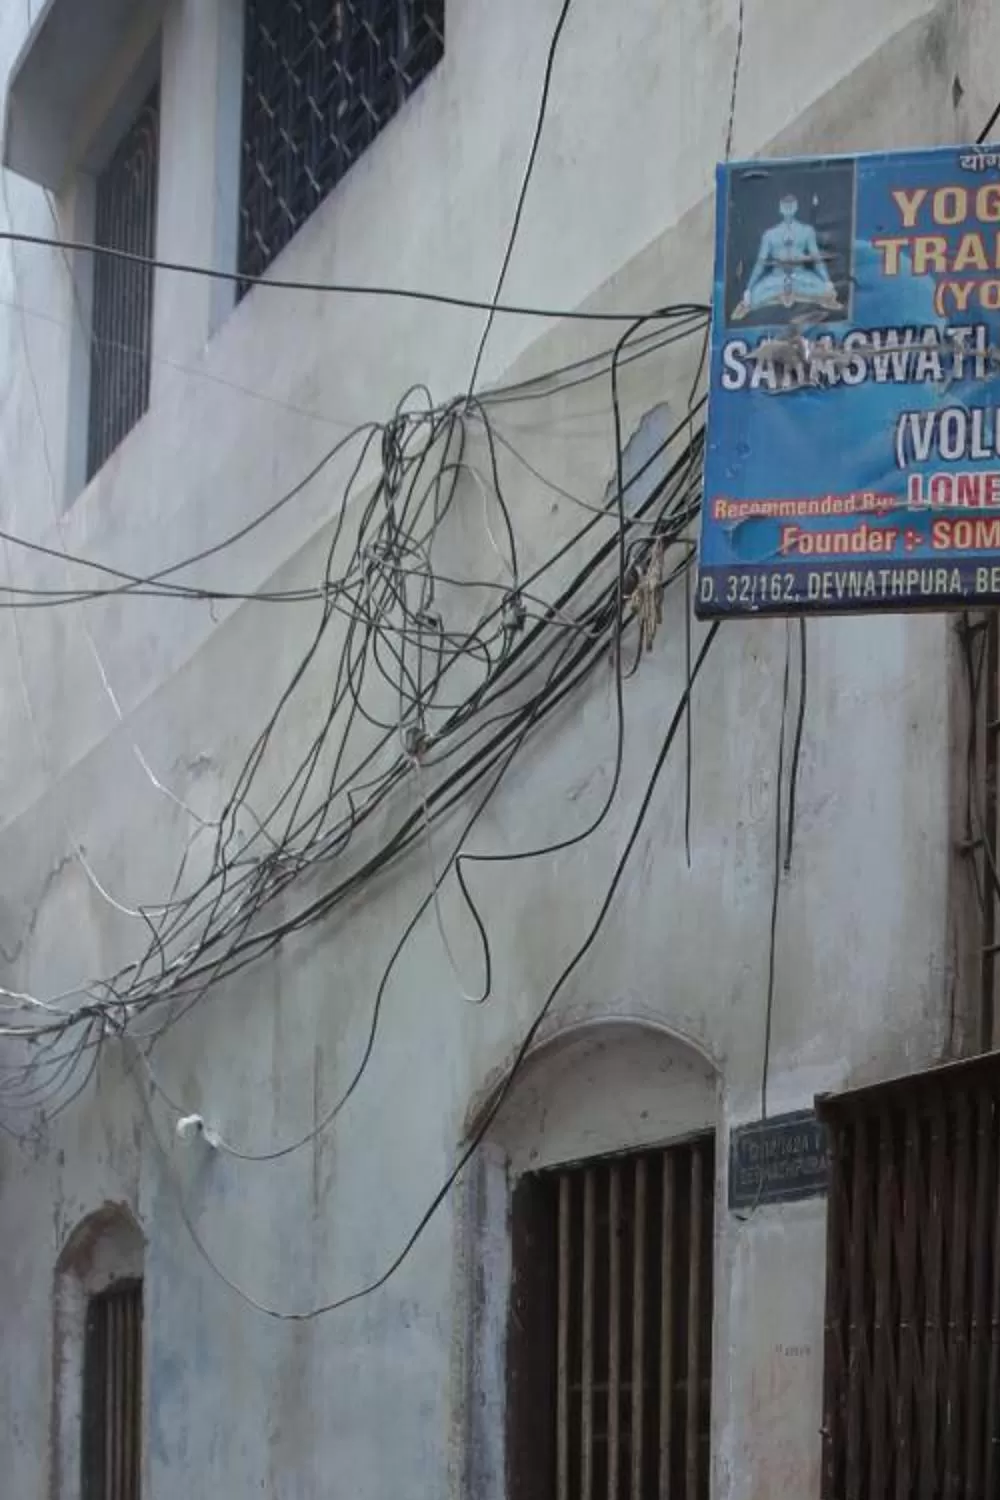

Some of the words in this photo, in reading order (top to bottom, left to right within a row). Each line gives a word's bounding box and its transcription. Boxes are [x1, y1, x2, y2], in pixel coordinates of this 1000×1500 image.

[714, 496, 855, 519] Recommended
[783, 525, 897, 555] Founder
[808, 568, 968, 599] DEVNATHPURA,
